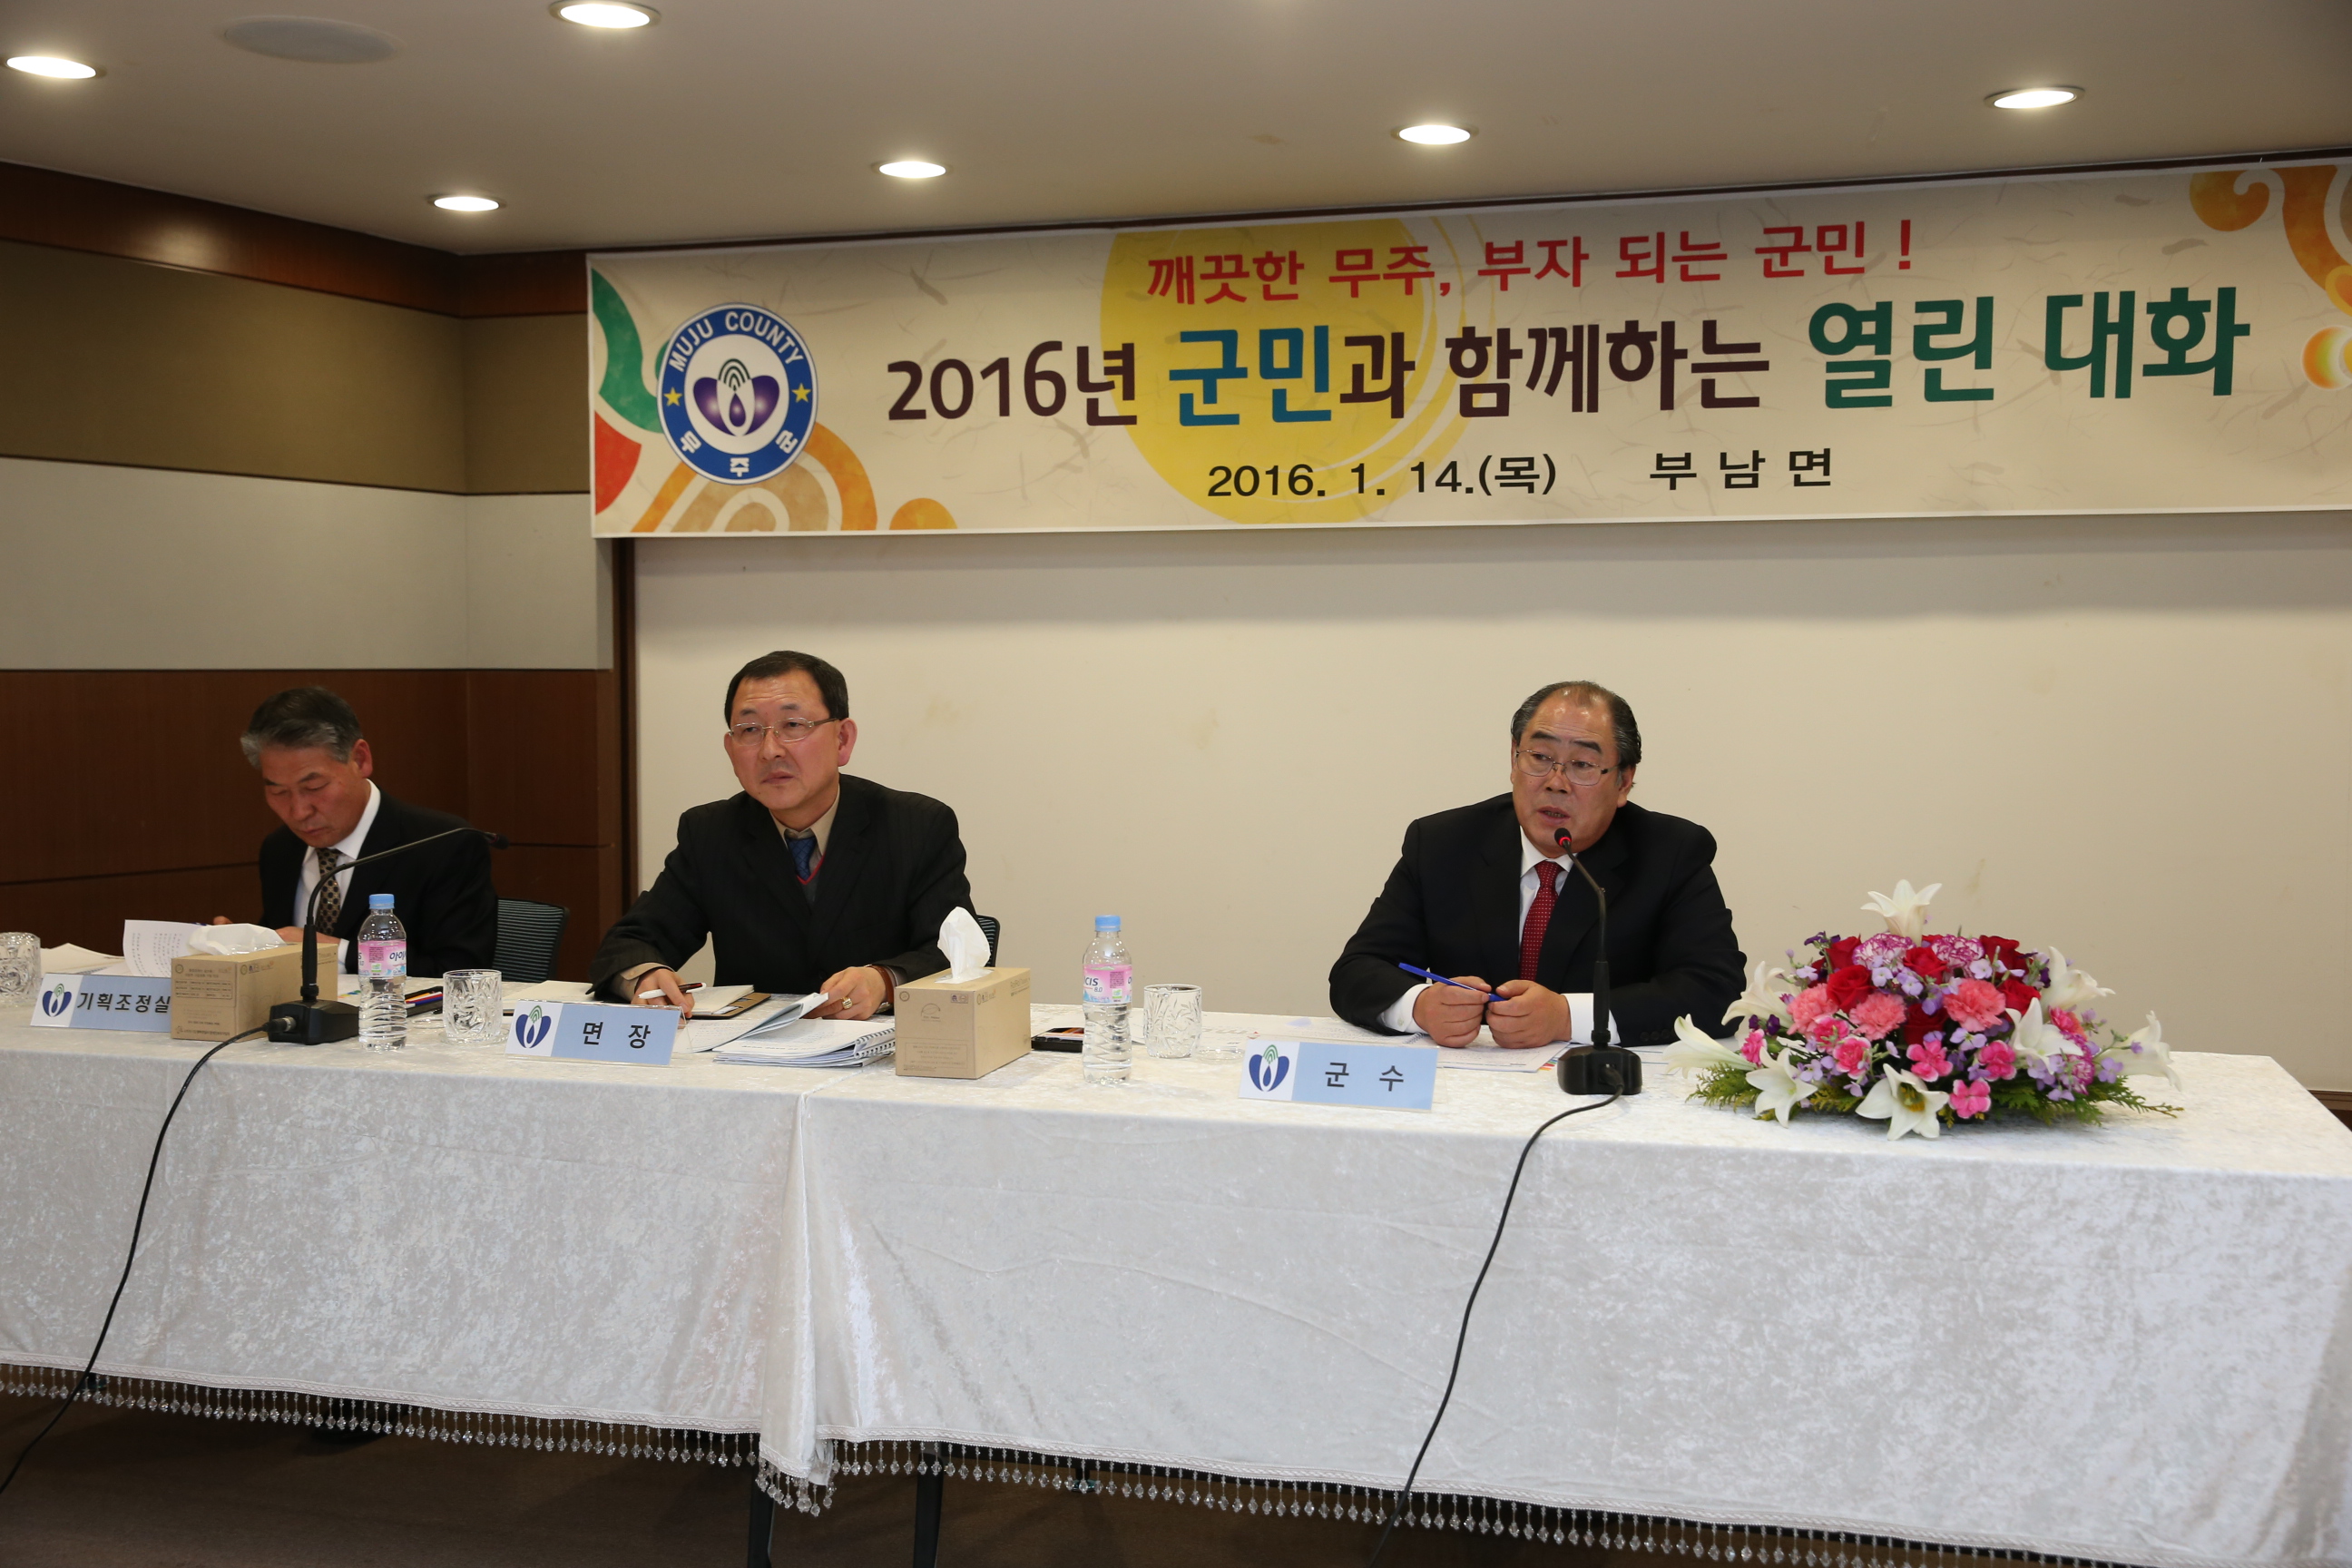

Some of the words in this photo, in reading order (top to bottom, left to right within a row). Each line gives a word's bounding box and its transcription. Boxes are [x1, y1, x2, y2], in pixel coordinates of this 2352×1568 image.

[1146, 250, 1305, 305] 깨끗한
[1328, 245, 1452, 298] 무주,
[1477, 236, 1590, 291] 부자
[1615, 231, 1728, 283] 되는
[1754, 221, 1867, 279] 군민
[669, 318, 713, 372] MUJU
[725, 311, 803, 365] COUNTY
[887, 340, 1139, 427] 2016년
[1168, 324, 1416, 427] 군민과
[1446, 318, 1770, 418] 함께하는
[1808, 296, 1995, 409] 열린
[2044, 286, 2250, 399] 대화
[1208, 464, 1327, 498] 2016.
[1410, 453, 1558, 496] 14.(목)
[77, 992, 171, 1014] 기획조정실
[1084, 976, 1099, 986] CIS
